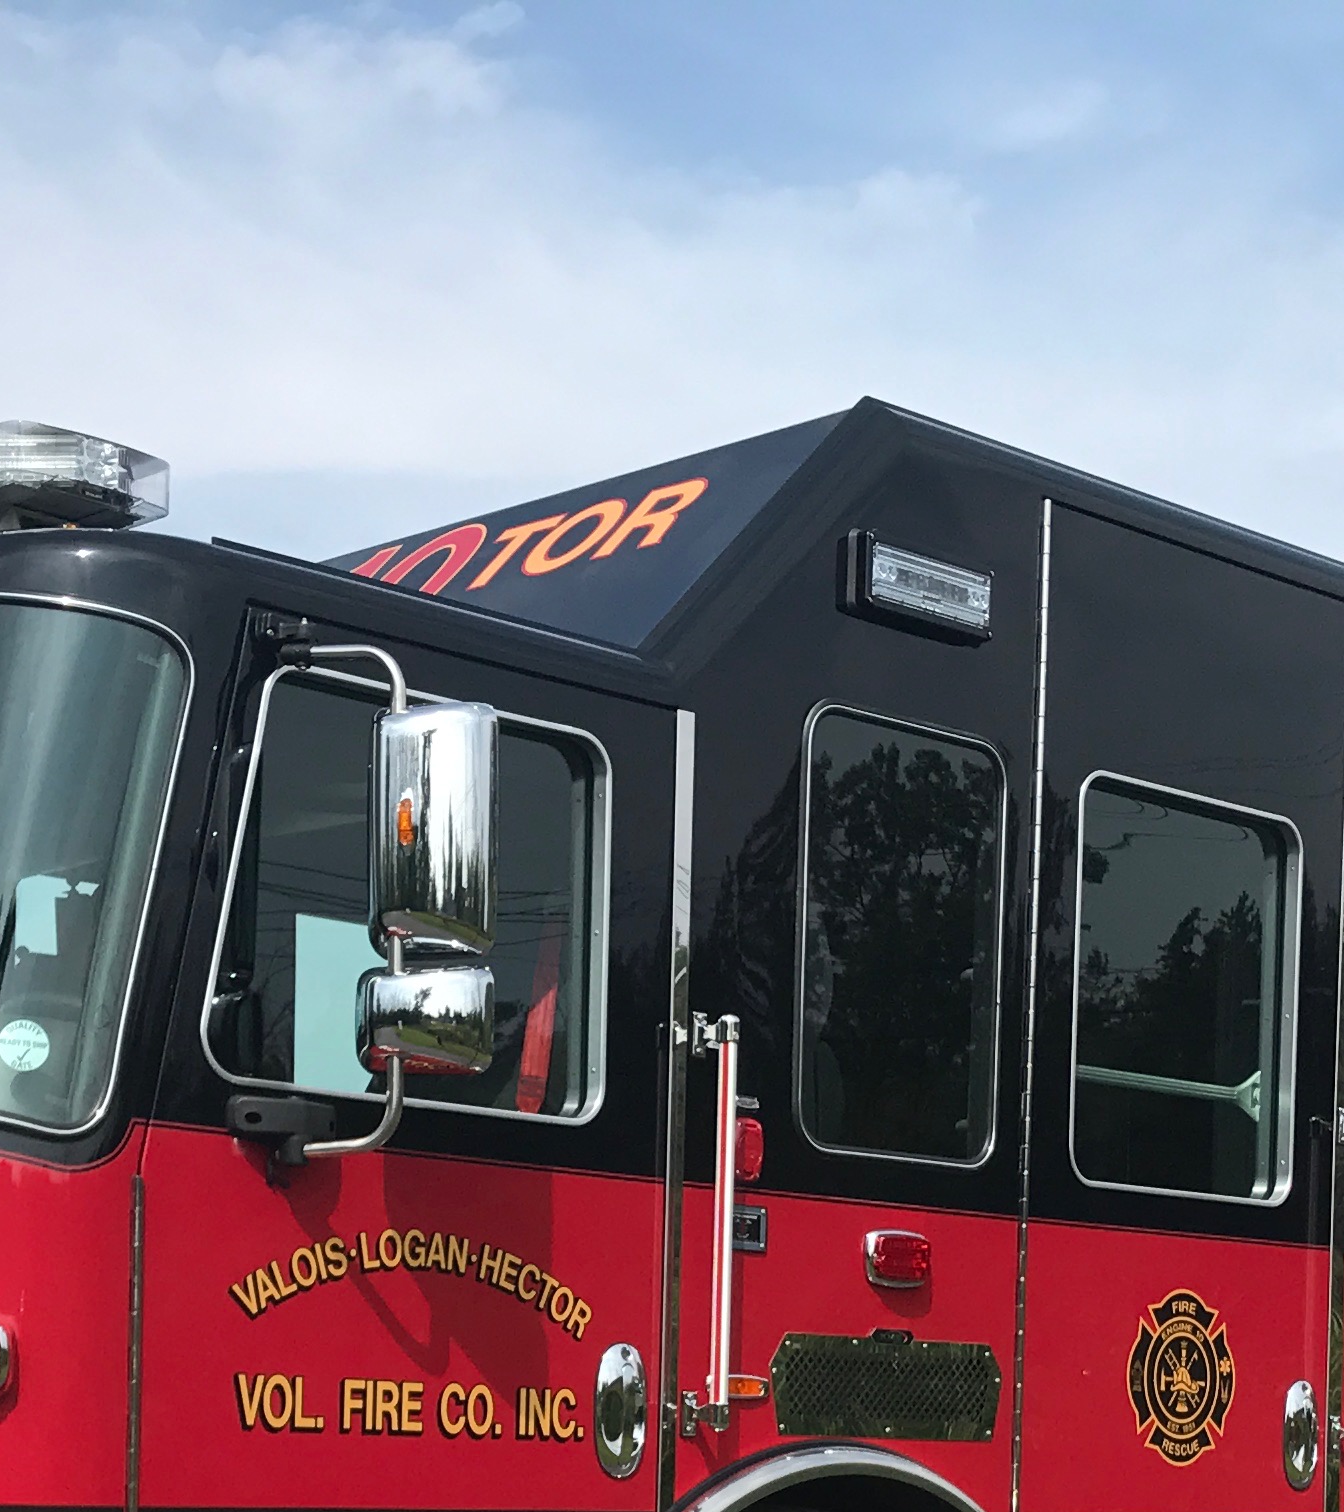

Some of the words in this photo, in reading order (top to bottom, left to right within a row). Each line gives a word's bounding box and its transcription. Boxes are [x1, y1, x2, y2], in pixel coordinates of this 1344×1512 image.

[7, 1021, 43, 1036] QUALITY
[1171, 1300, 1197, 1316] FIRE
[1161, 1323, 1193, 1341] ENGINE
[1196, 1330, 1205, 1343] 10
[234, 1372, 324, 1431] VOL.
[339, 1377, 424, 1435] FIRE
[437, 1381, 502, 1439] CO.
[515, 1386, 585, 1440] INC.
[1161, 1437, 1200, 1457] RESCUE
